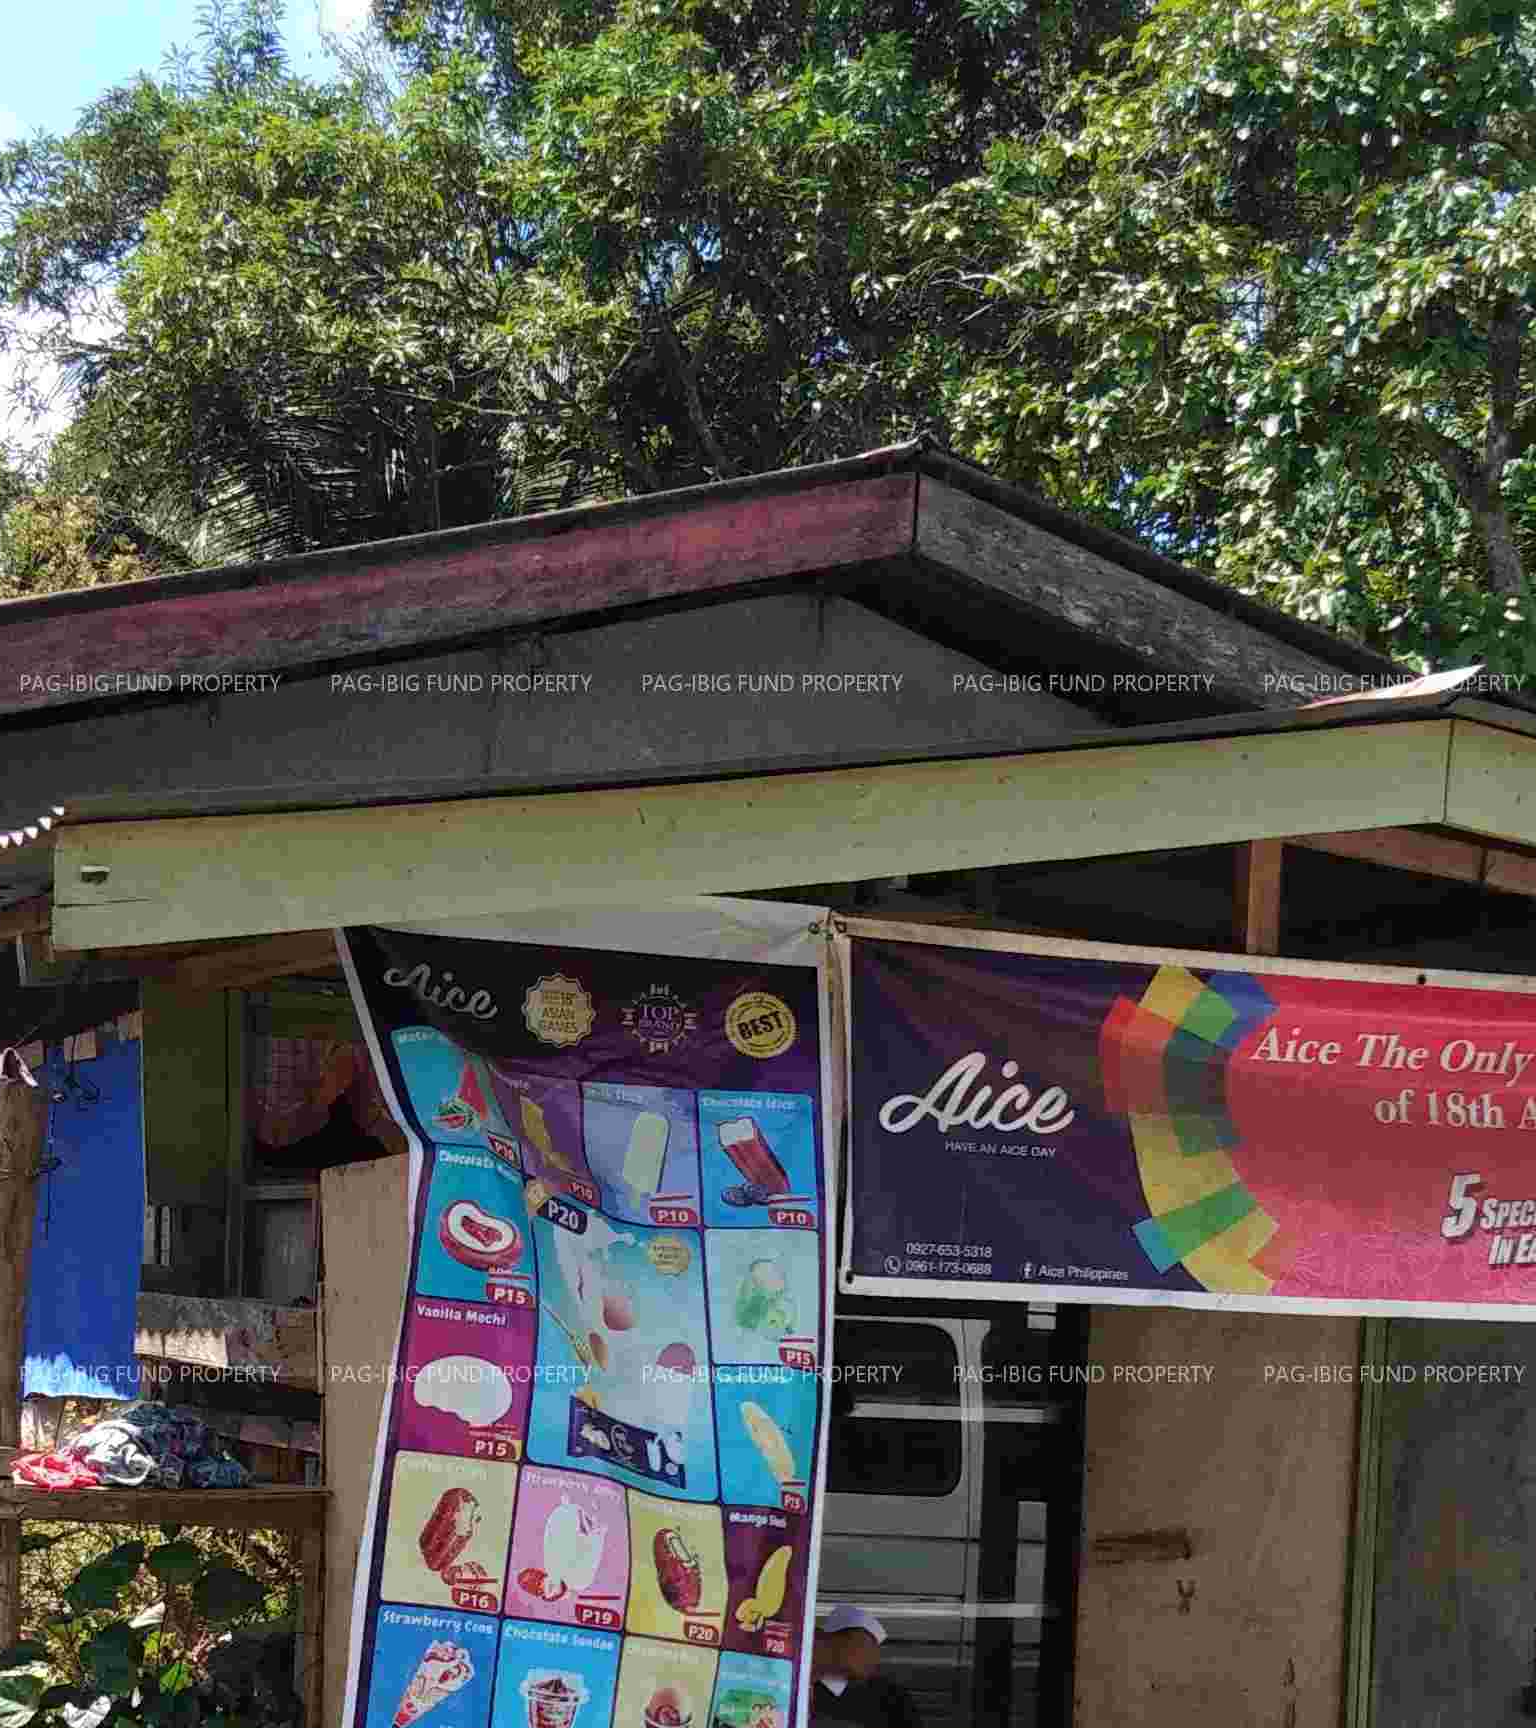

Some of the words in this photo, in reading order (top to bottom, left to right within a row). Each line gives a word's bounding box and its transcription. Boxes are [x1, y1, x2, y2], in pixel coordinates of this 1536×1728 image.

[384, 963, 498, 1019] Aice
[737, 1009, 783, 1040] BEST
[1251, 1025, 1343, 1065] Aice
[1356, 1033, 1429, 1070] The
[1440, 1039, 1534, 1087] Only
[879, 1051, 1075, 1134] Aice
[1374, 1089, 1414, 1125] of
[1425, 1090, 1506, 1130] 18th
[944, 1140, 976, 1152] HAVE
[977, 1142, 997, 1154] AN
[1031, 1146, 1056, 1158] DAY
[548, 1199, 579, 1230] P20
[1441, 1173, 1481, 1238] 5
[657, 1209, 689, 1223] P10
[777, 1211, 808, 1224] P10
[905, 1242, 993, 1258] 0927-653-5318
[1038, 1265, 1065, 1277] Aice
[1067, 1265, 1129, 1281] Philippines
[494, 1287, 527, 1304] P15
[416, 1303, 462, 1320] Vanilla
[466, 1310, 506, 1327] Mochi
[784, 1350, 811, 1366] P15
[474, 1441, 507, 1457] P15
[460, 1593, 489, 1608] P16
[383, 1610, 462, 1632] Strawberry
[464, 1619, 493, 1634] Cone
[582, 1609, 612, 1624] P19
[504, 1624, 567, 1644] Chocolate
[688, 1624, 713, 1641] P20
